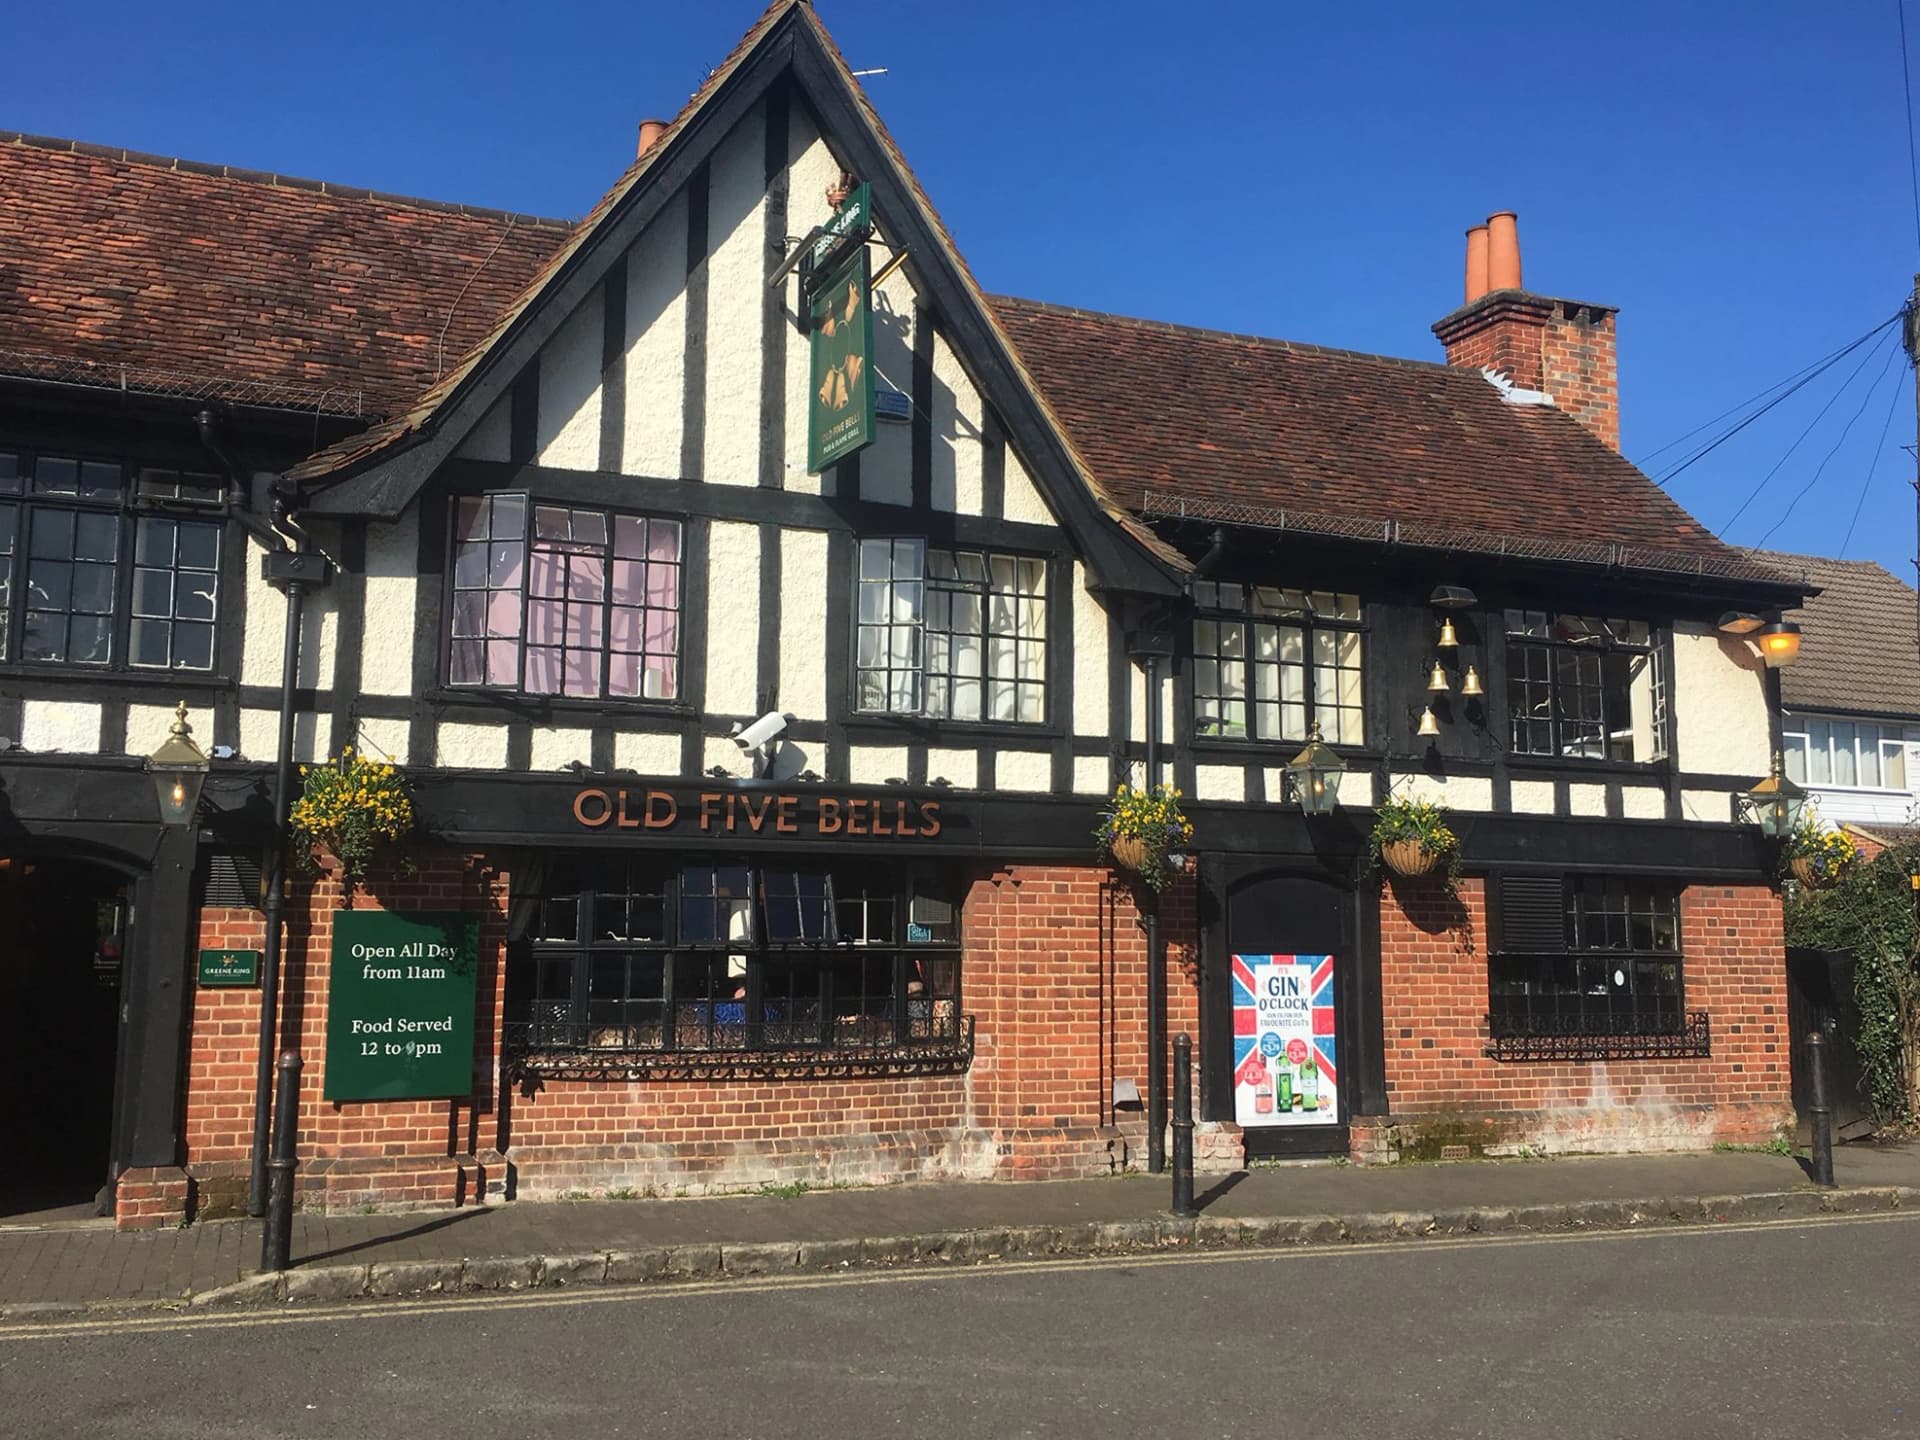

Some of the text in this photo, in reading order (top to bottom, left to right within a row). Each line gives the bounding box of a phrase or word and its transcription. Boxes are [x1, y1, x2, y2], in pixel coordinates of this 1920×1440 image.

[573, 789, 941, 837] OLD FIVE BELLS
[351, 942, 458, 961] Open All Day
[363, 964, 445, 979] from 11am
[1268, 976, 1299, 997] GIN
[1259, 998, 1309, 1012] O'CLOCK
[351, 1016, 452, 1034] Food Served
[360, 1041, 378, 1056] 12
[385, 1042, 401, 1055] to
